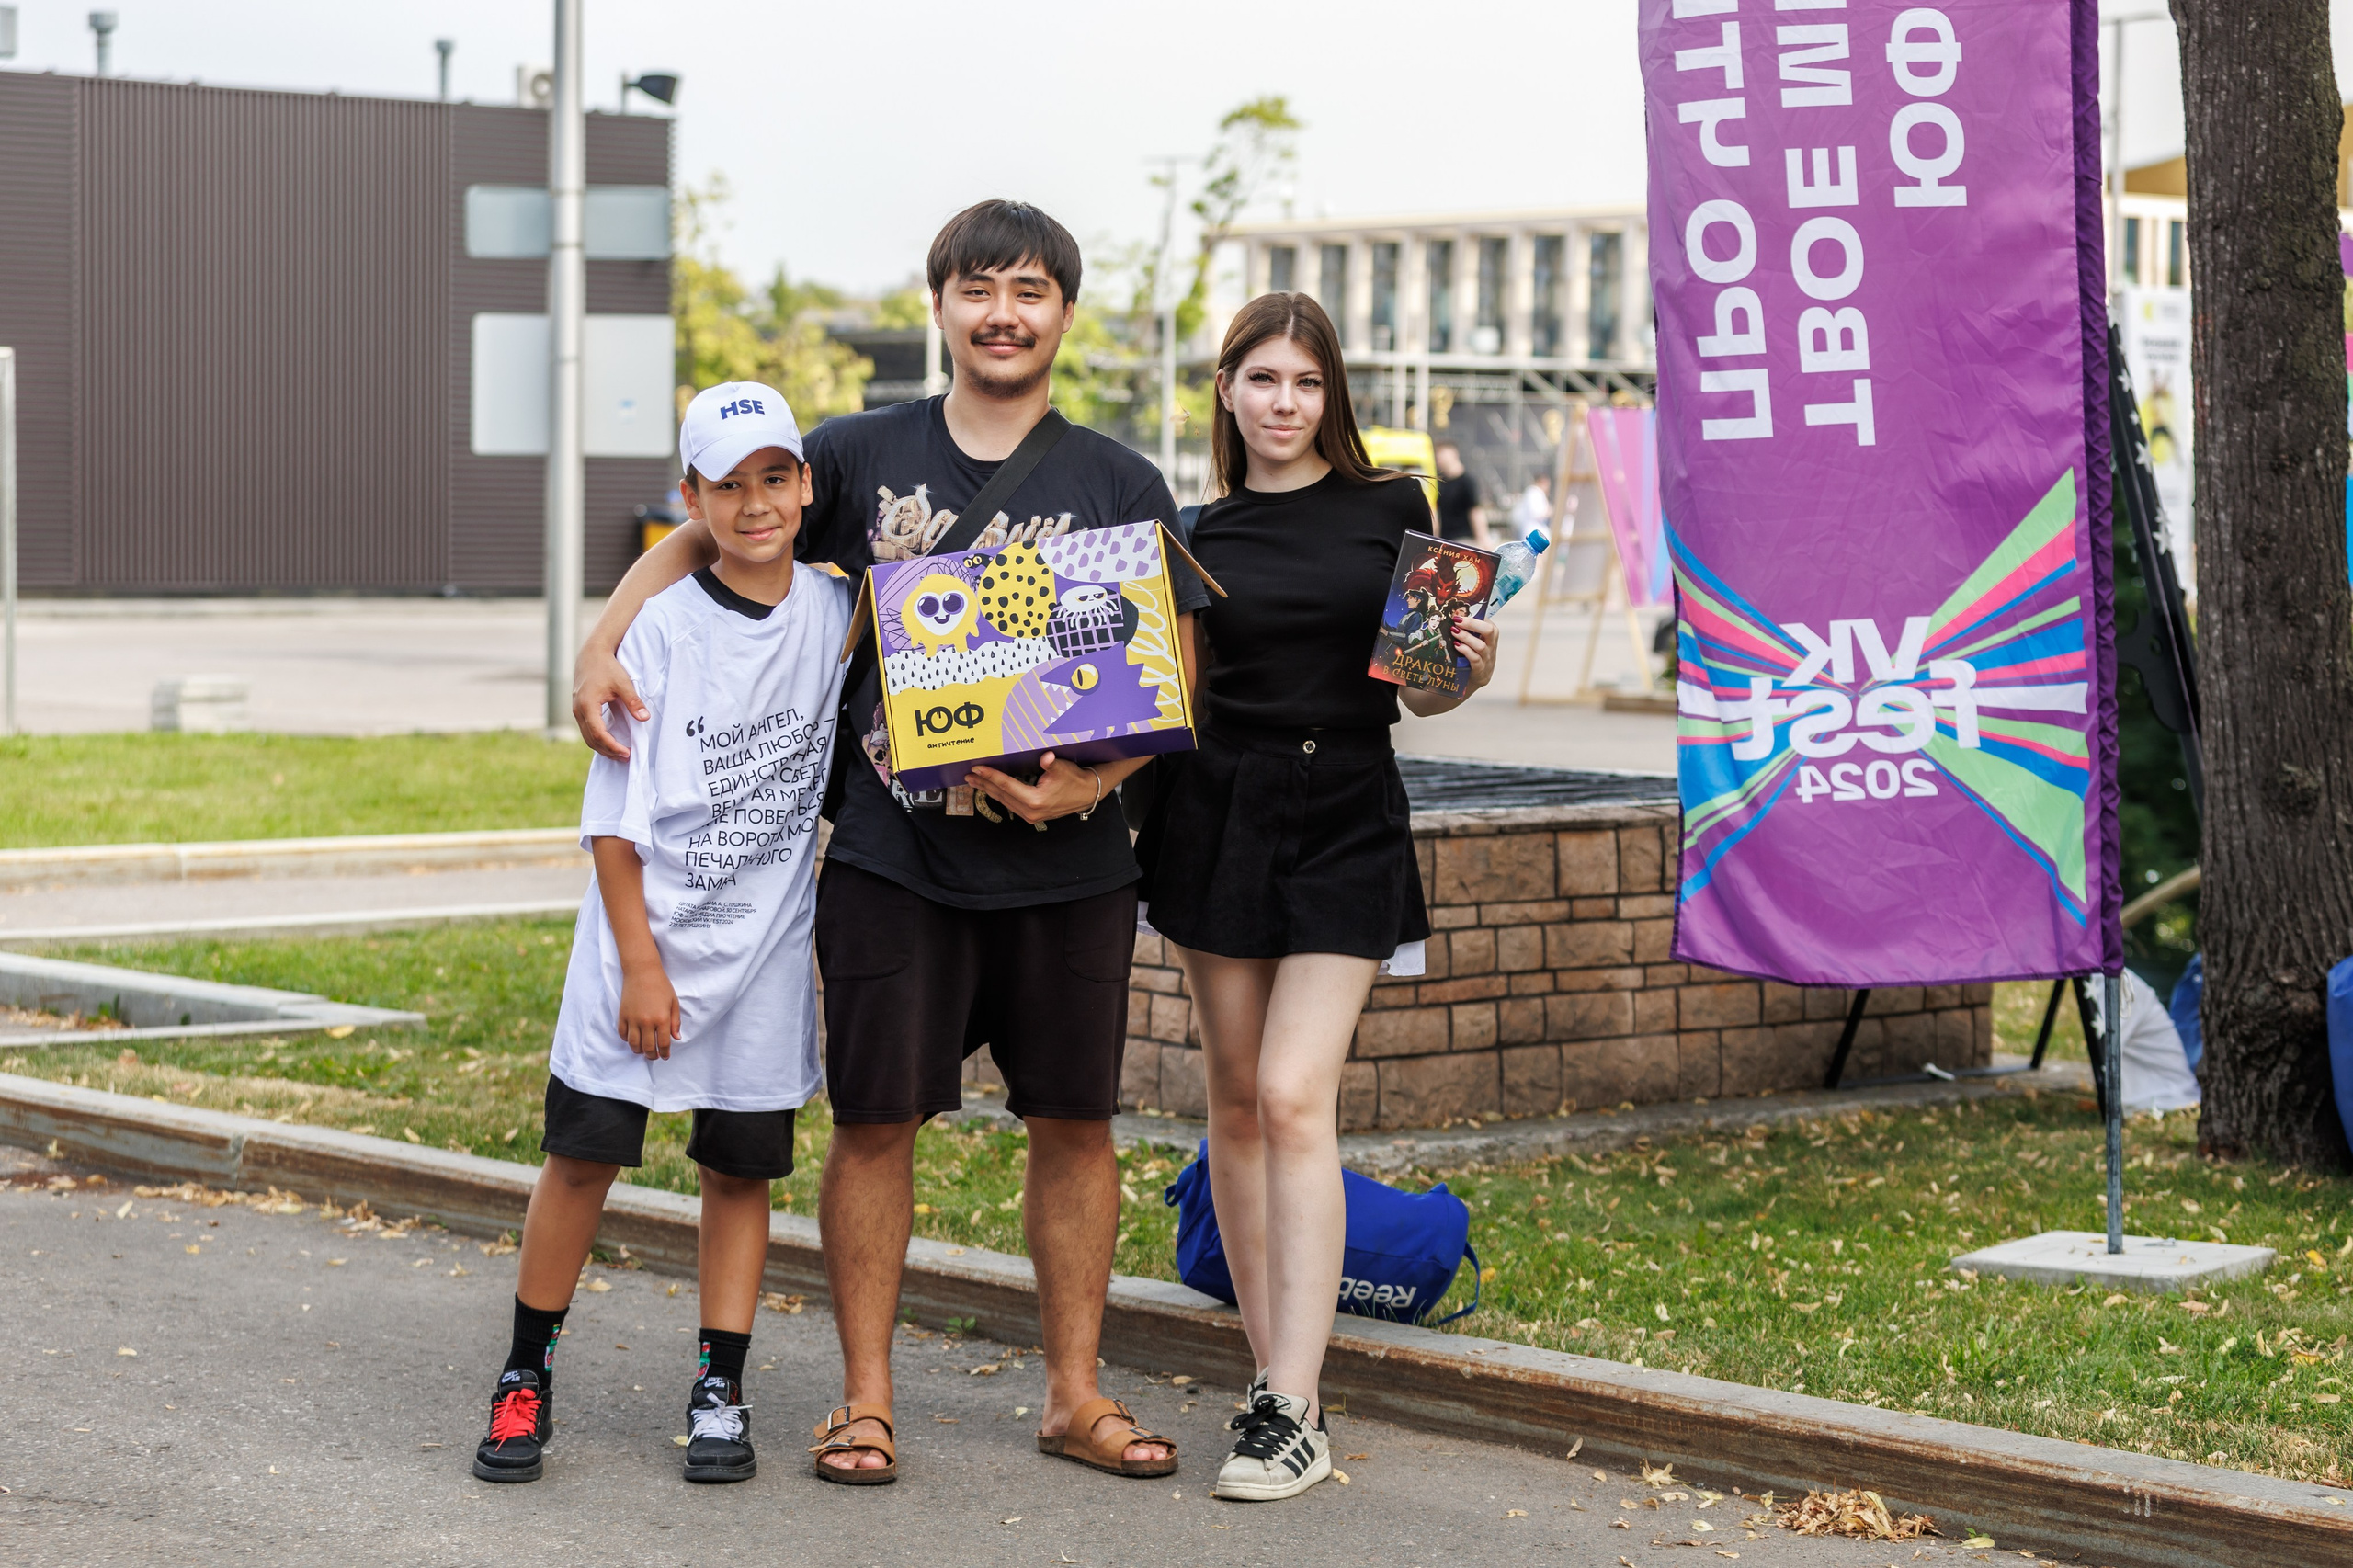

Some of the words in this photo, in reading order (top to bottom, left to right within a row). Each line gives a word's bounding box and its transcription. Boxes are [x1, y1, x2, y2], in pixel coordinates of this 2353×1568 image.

[720, 399, 766, 420] HSE
[1427, 545, 1461, 560] КСЕНИЯ
[1462, 553, 1481, 565] ХАН
[1382, 665, 1389, 675] В
[1392, 668, 1424, 685] СВЕТЕ
[1427, 676, 1460, 692] ЛУНЫ
[1392, 653, 1457, 679] ДРАКОН
[700, 723, 744, 752] МОЙ
[748, 708, 804, 741] АНГЕЛ,
[915, 701, 984, 737] ЮФ
[927, 736, 975, 749] античтение
[703, 748, 756, 775] ВАША
[688, 832, 712, 849] НА
[1338, 1276, 1417, 1308] Reeb
